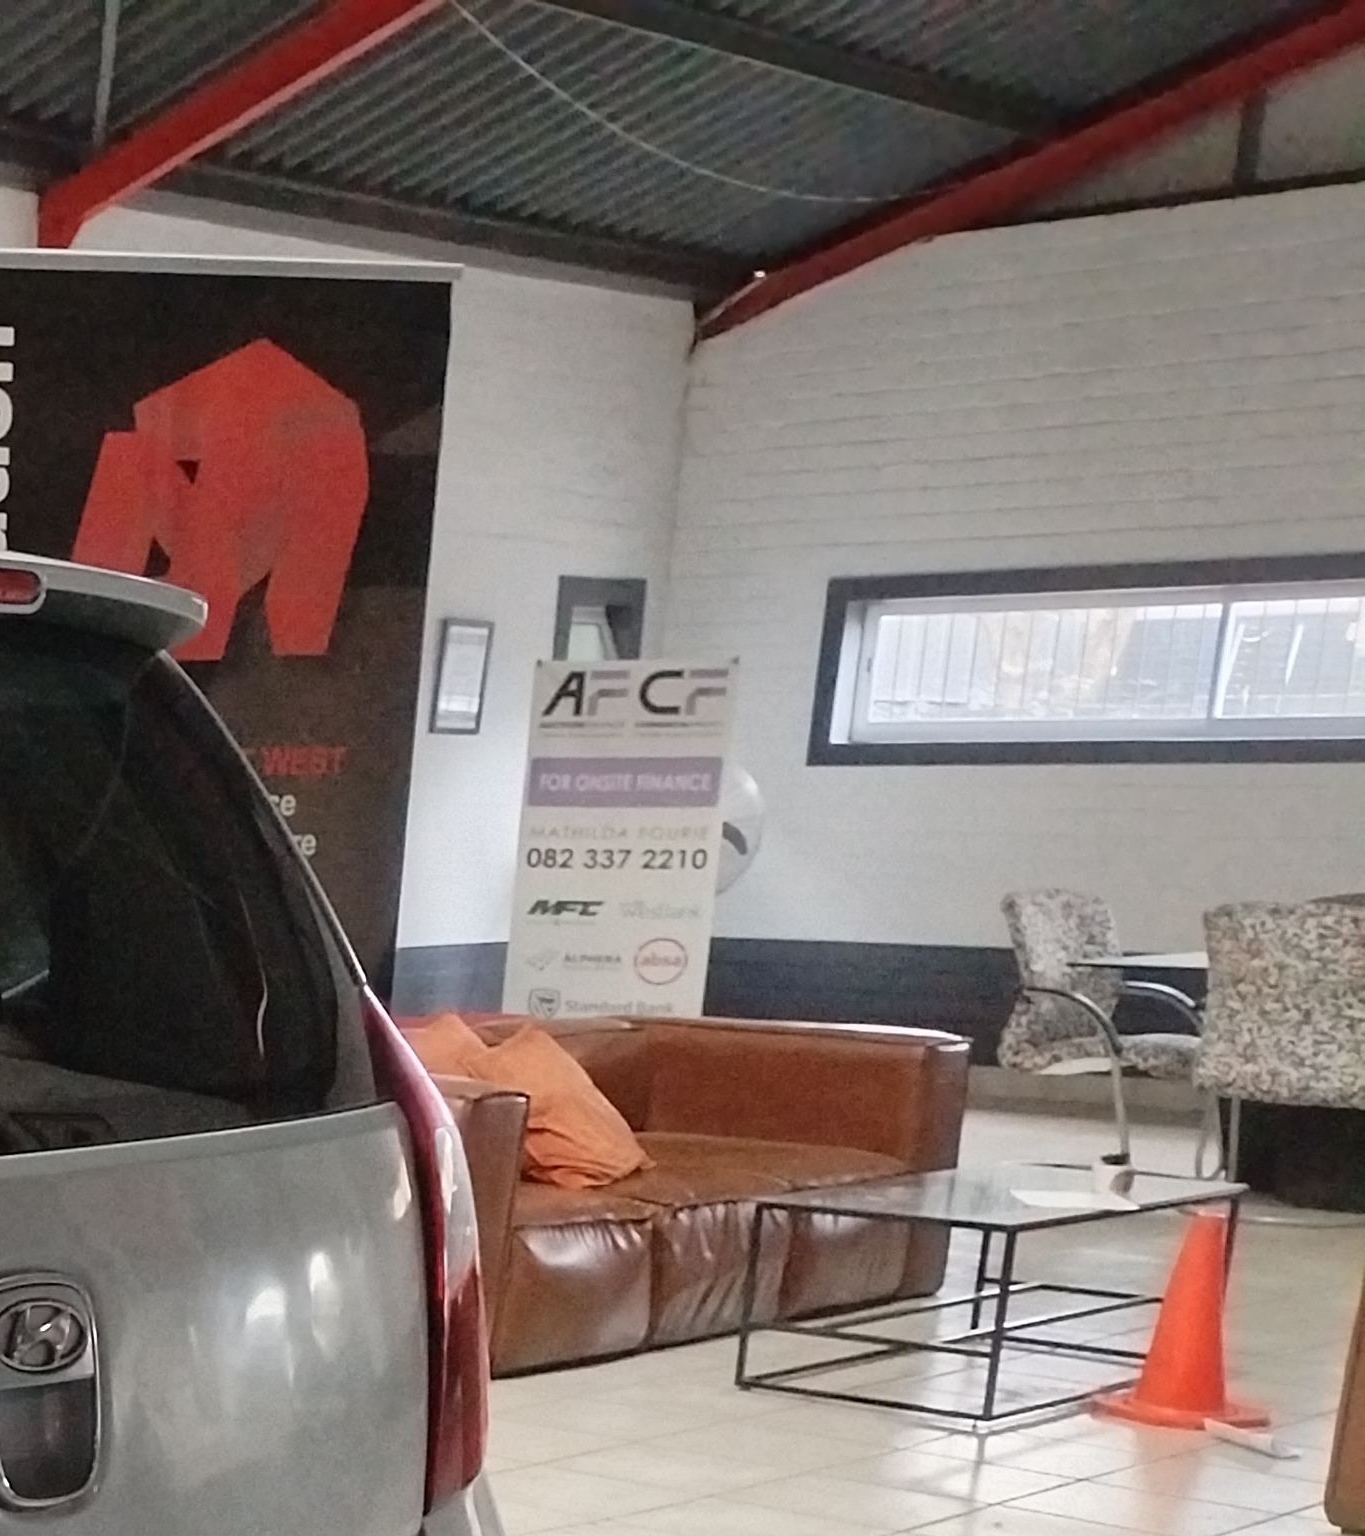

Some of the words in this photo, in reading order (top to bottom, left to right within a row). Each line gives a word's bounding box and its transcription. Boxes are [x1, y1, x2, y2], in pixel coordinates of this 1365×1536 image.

[261, 744, 347, 776] WEST
[538, 772, 571, 793] FOR
[575, 772, 633, 793] ONSITE
[636, 772, 712, 793] FINANCE
[526, 847, 574, 870] 082
[583, 848, 631, 870] 337
[641, 848, 708, 870] 2210
